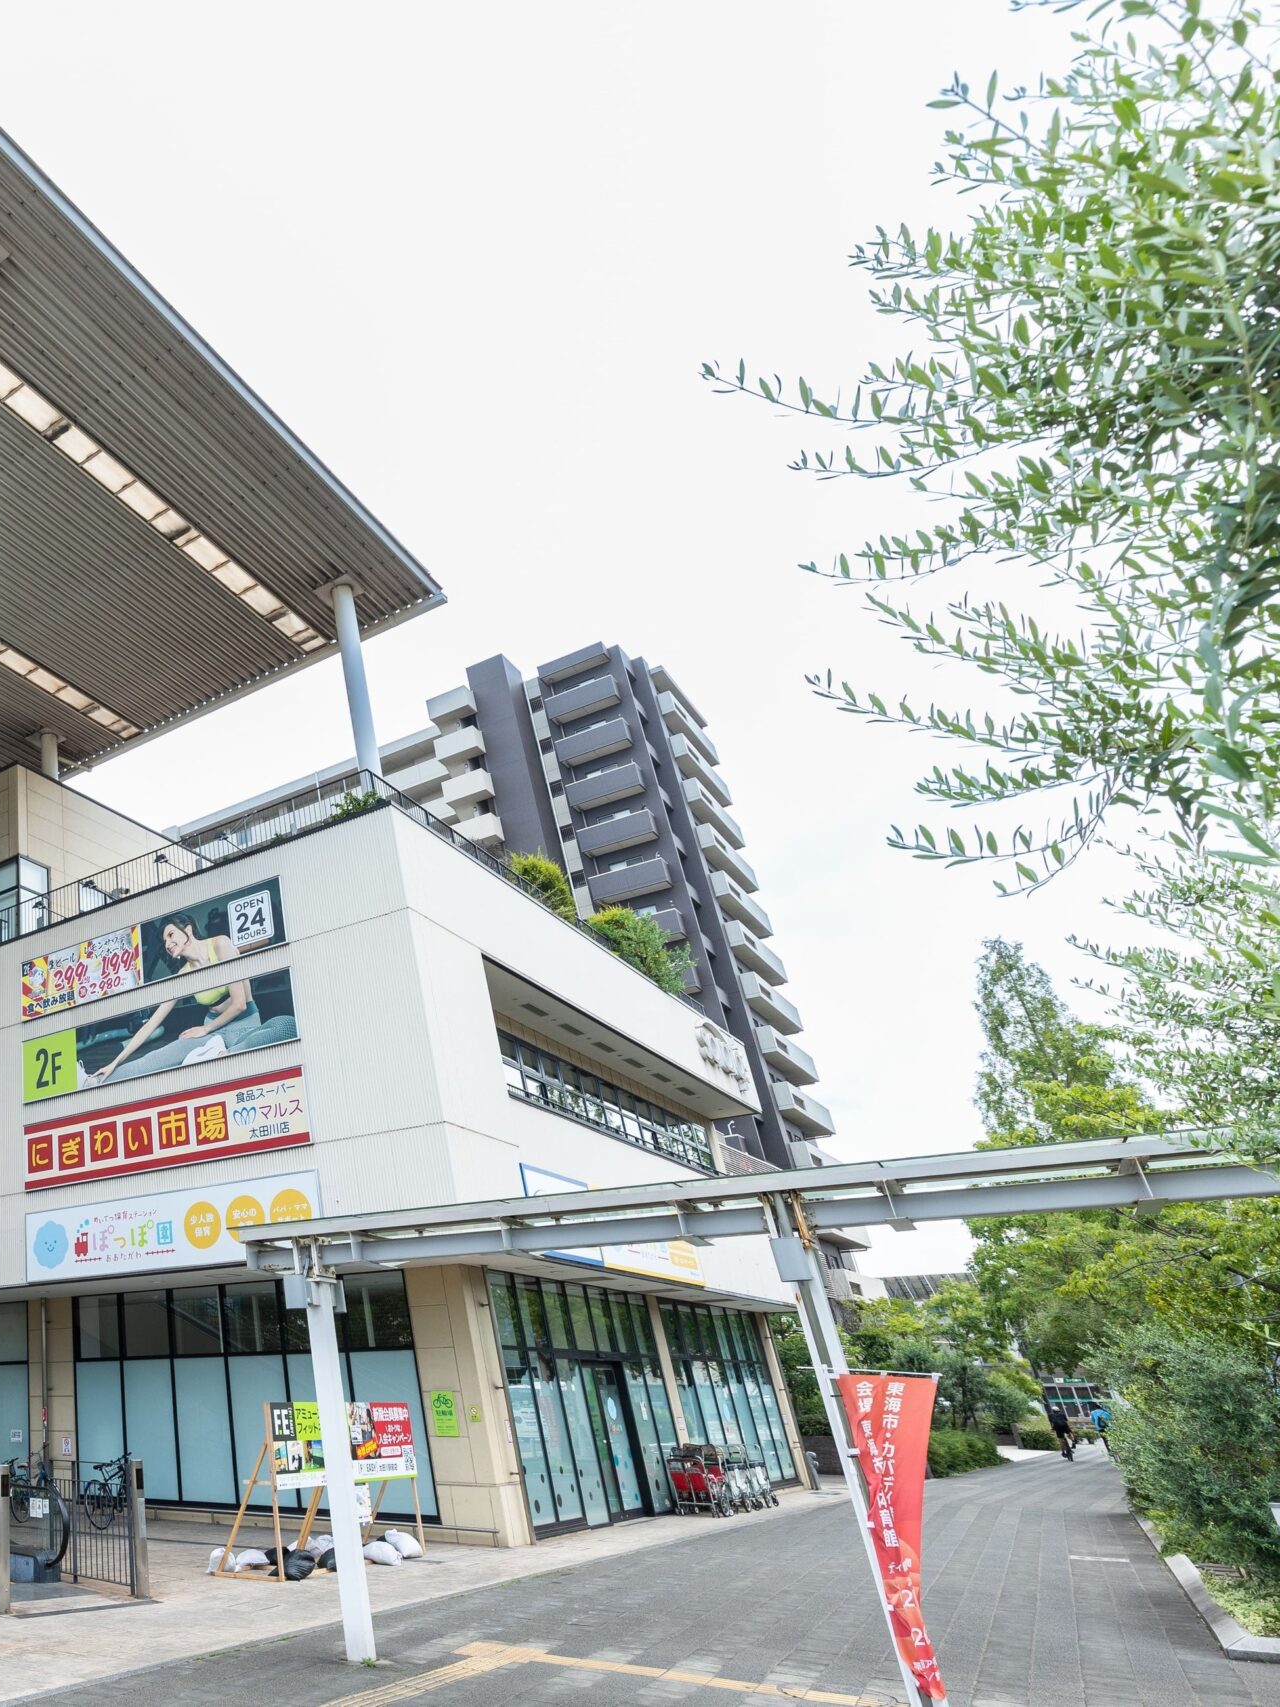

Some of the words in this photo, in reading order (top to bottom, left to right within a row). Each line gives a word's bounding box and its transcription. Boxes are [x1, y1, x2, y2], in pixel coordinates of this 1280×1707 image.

[234, 896, 264, 912] OPEN
[236, 907, 266, 934] 24
[237, 927, 267, 942] HOURS
[53, 961, 88, 991] 299
[27, 990, 75, 1013] 食べ飲み放題
[35, 1048, 63, 1089] 2F
[236, 1084, 296, 1104] 食品スーパー
[258, 1098, 304, 1121] マルス
[31, 1105, 227, 1167] にぎわい市場
[248, 1121, 290, 1140] 太田川店
[232, 1208, 257, 1219] 安心の
[106, 1251, 142, 1262] おおたがわ
[856, 1381, 874, 1413] 会場
[273, 1409, 290, 1436] FE
[295, 1408, 319, 1420] アミュー
[297, 1422, 321, 1434] フィット
[881, 1381, 907, 1512] 東海市・カバディ
